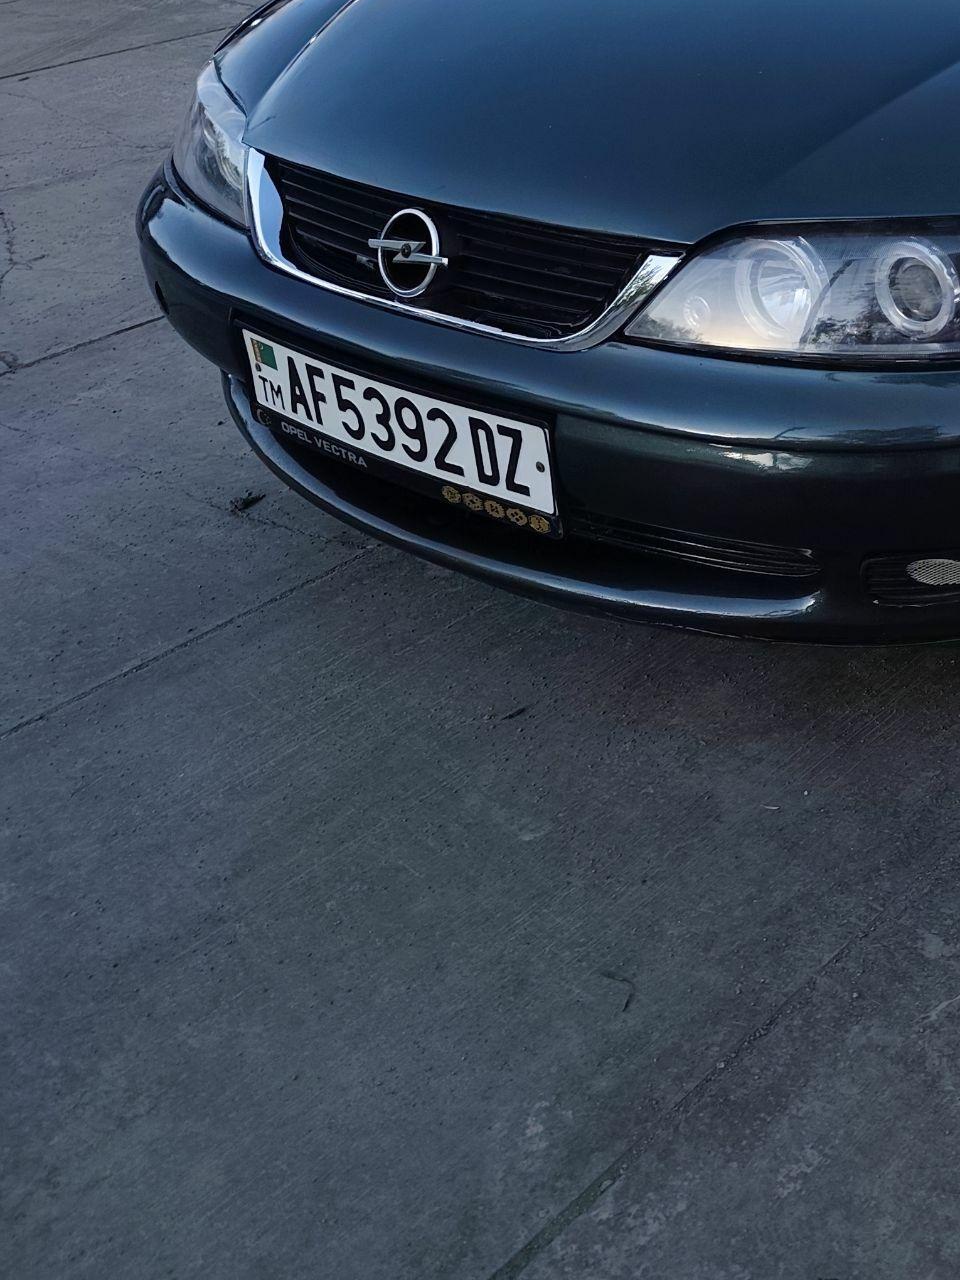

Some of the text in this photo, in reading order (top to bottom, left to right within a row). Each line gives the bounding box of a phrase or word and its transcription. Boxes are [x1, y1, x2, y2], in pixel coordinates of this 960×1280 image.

[259, 375, 285, 410] TM
[281, 421, 368, 468] OPEL VECTRA
